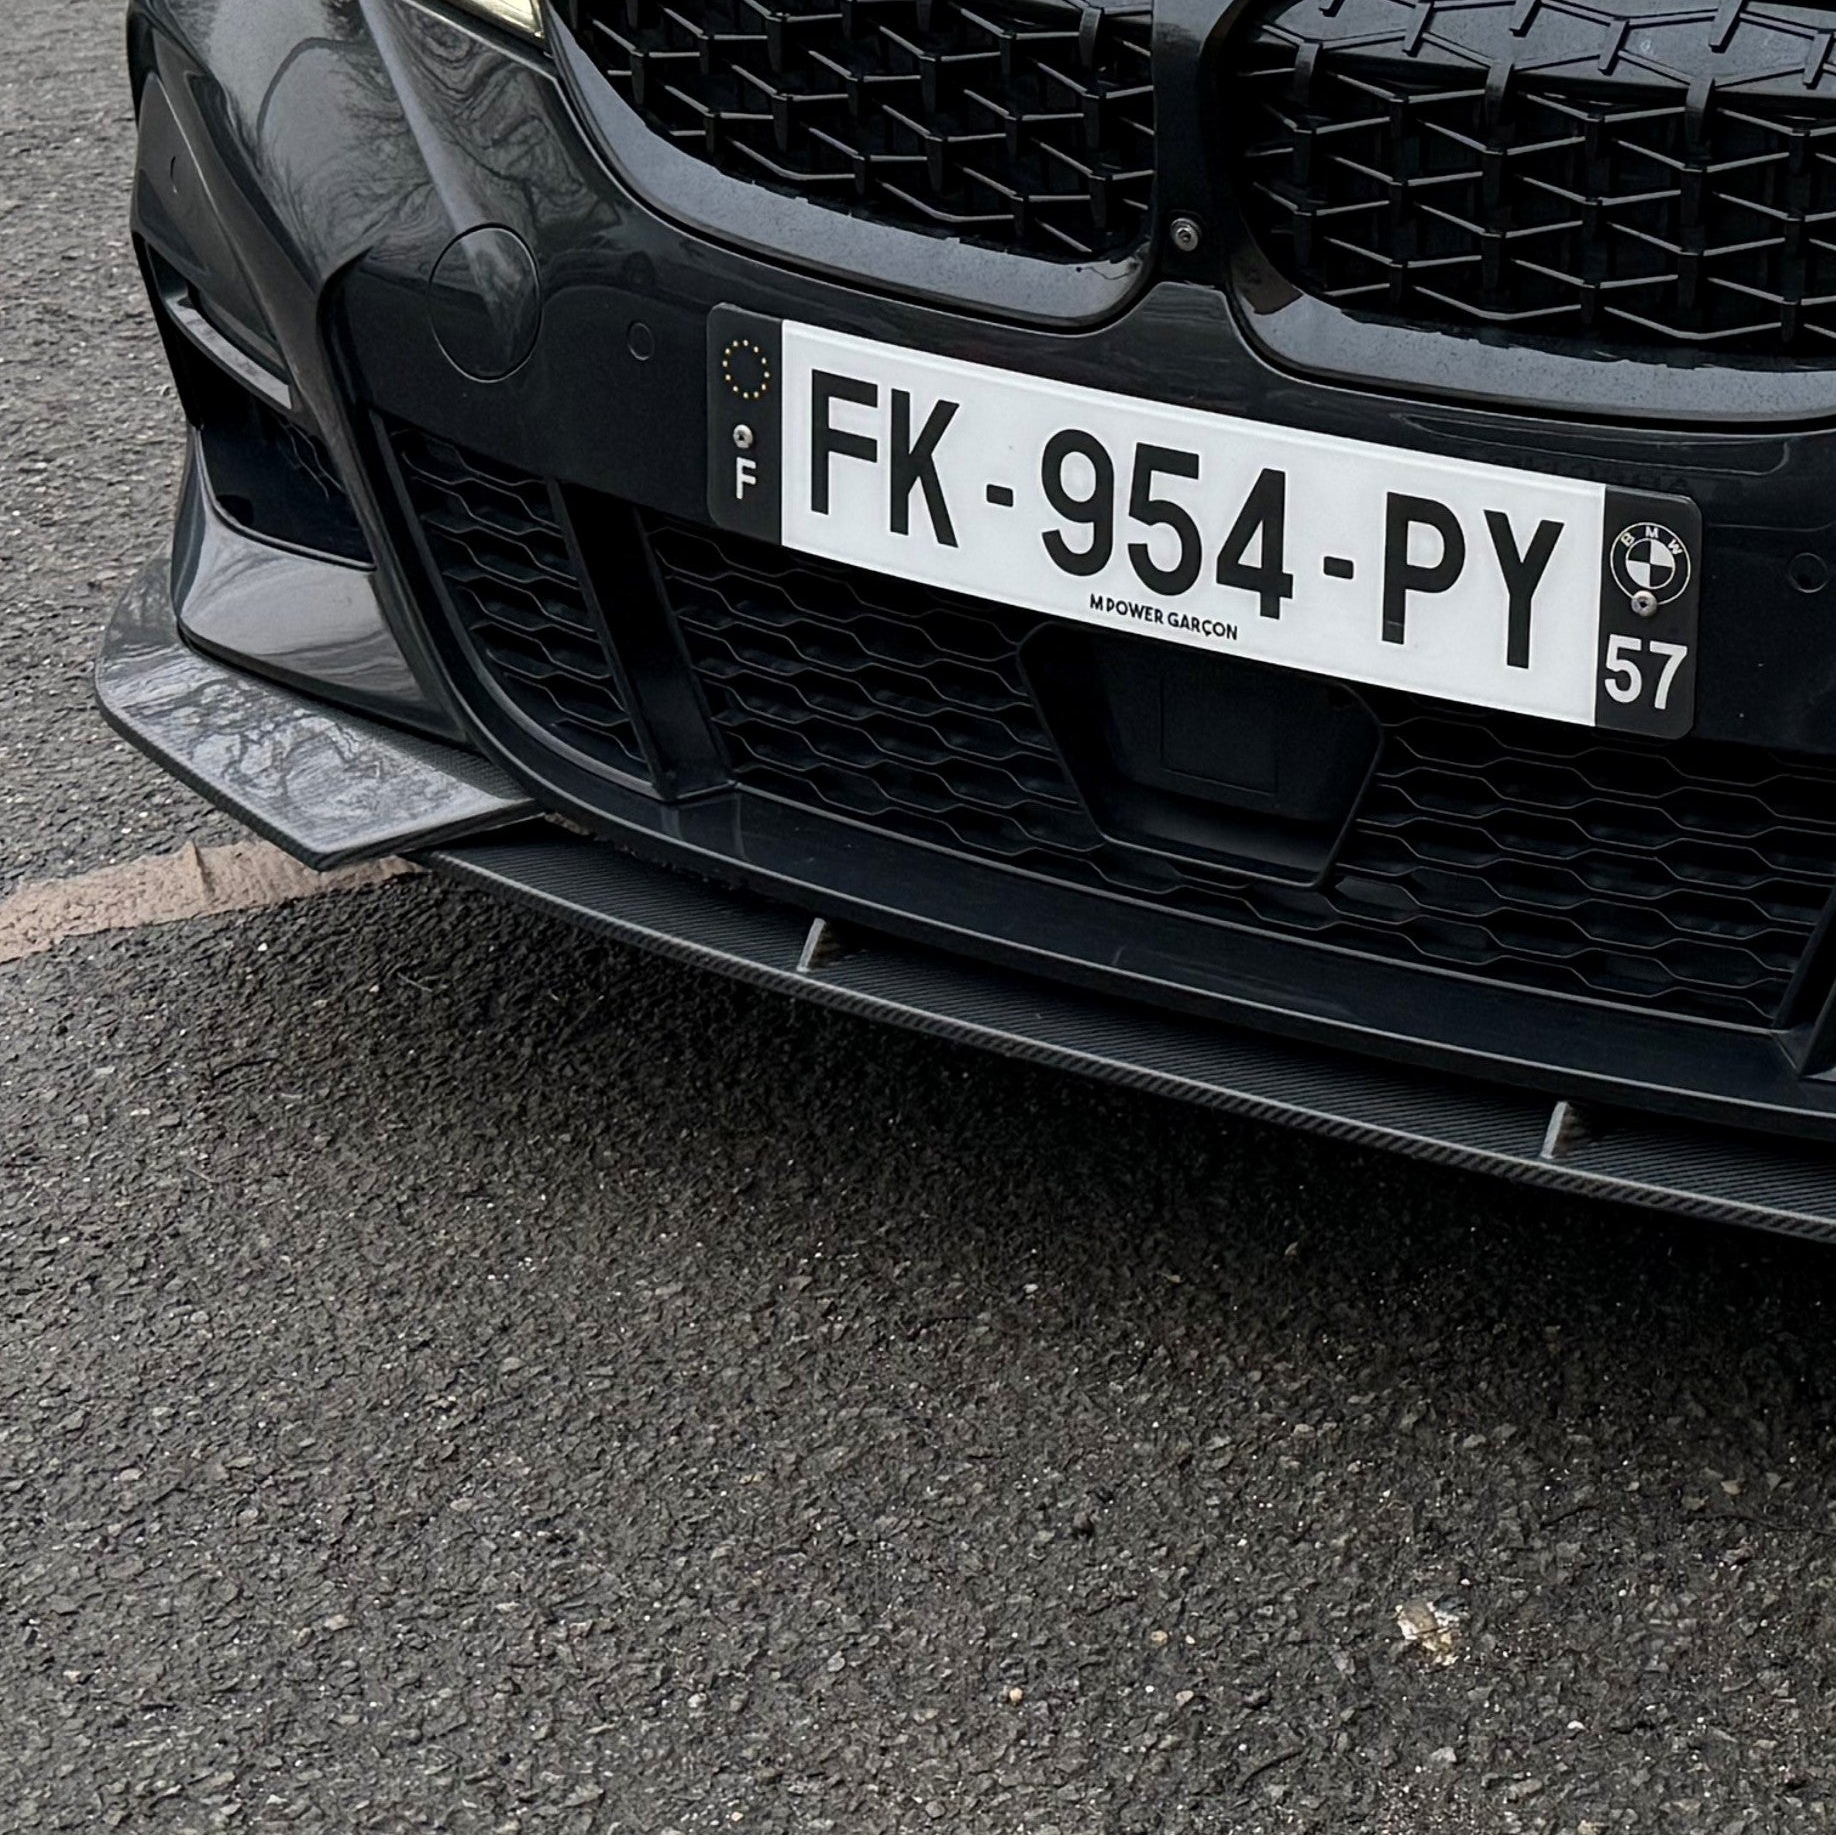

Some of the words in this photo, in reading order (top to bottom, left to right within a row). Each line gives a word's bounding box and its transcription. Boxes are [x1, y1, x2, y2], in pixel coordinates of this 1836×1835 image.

[735, 456, 757, 500] F
[810, 368, 1565, 670] FK-954-PY
[1620, 525, 1683, 556] BMW
[1167, 611, 1238, 641] GARÇON
[1604, 633, 1688, 710] 57
